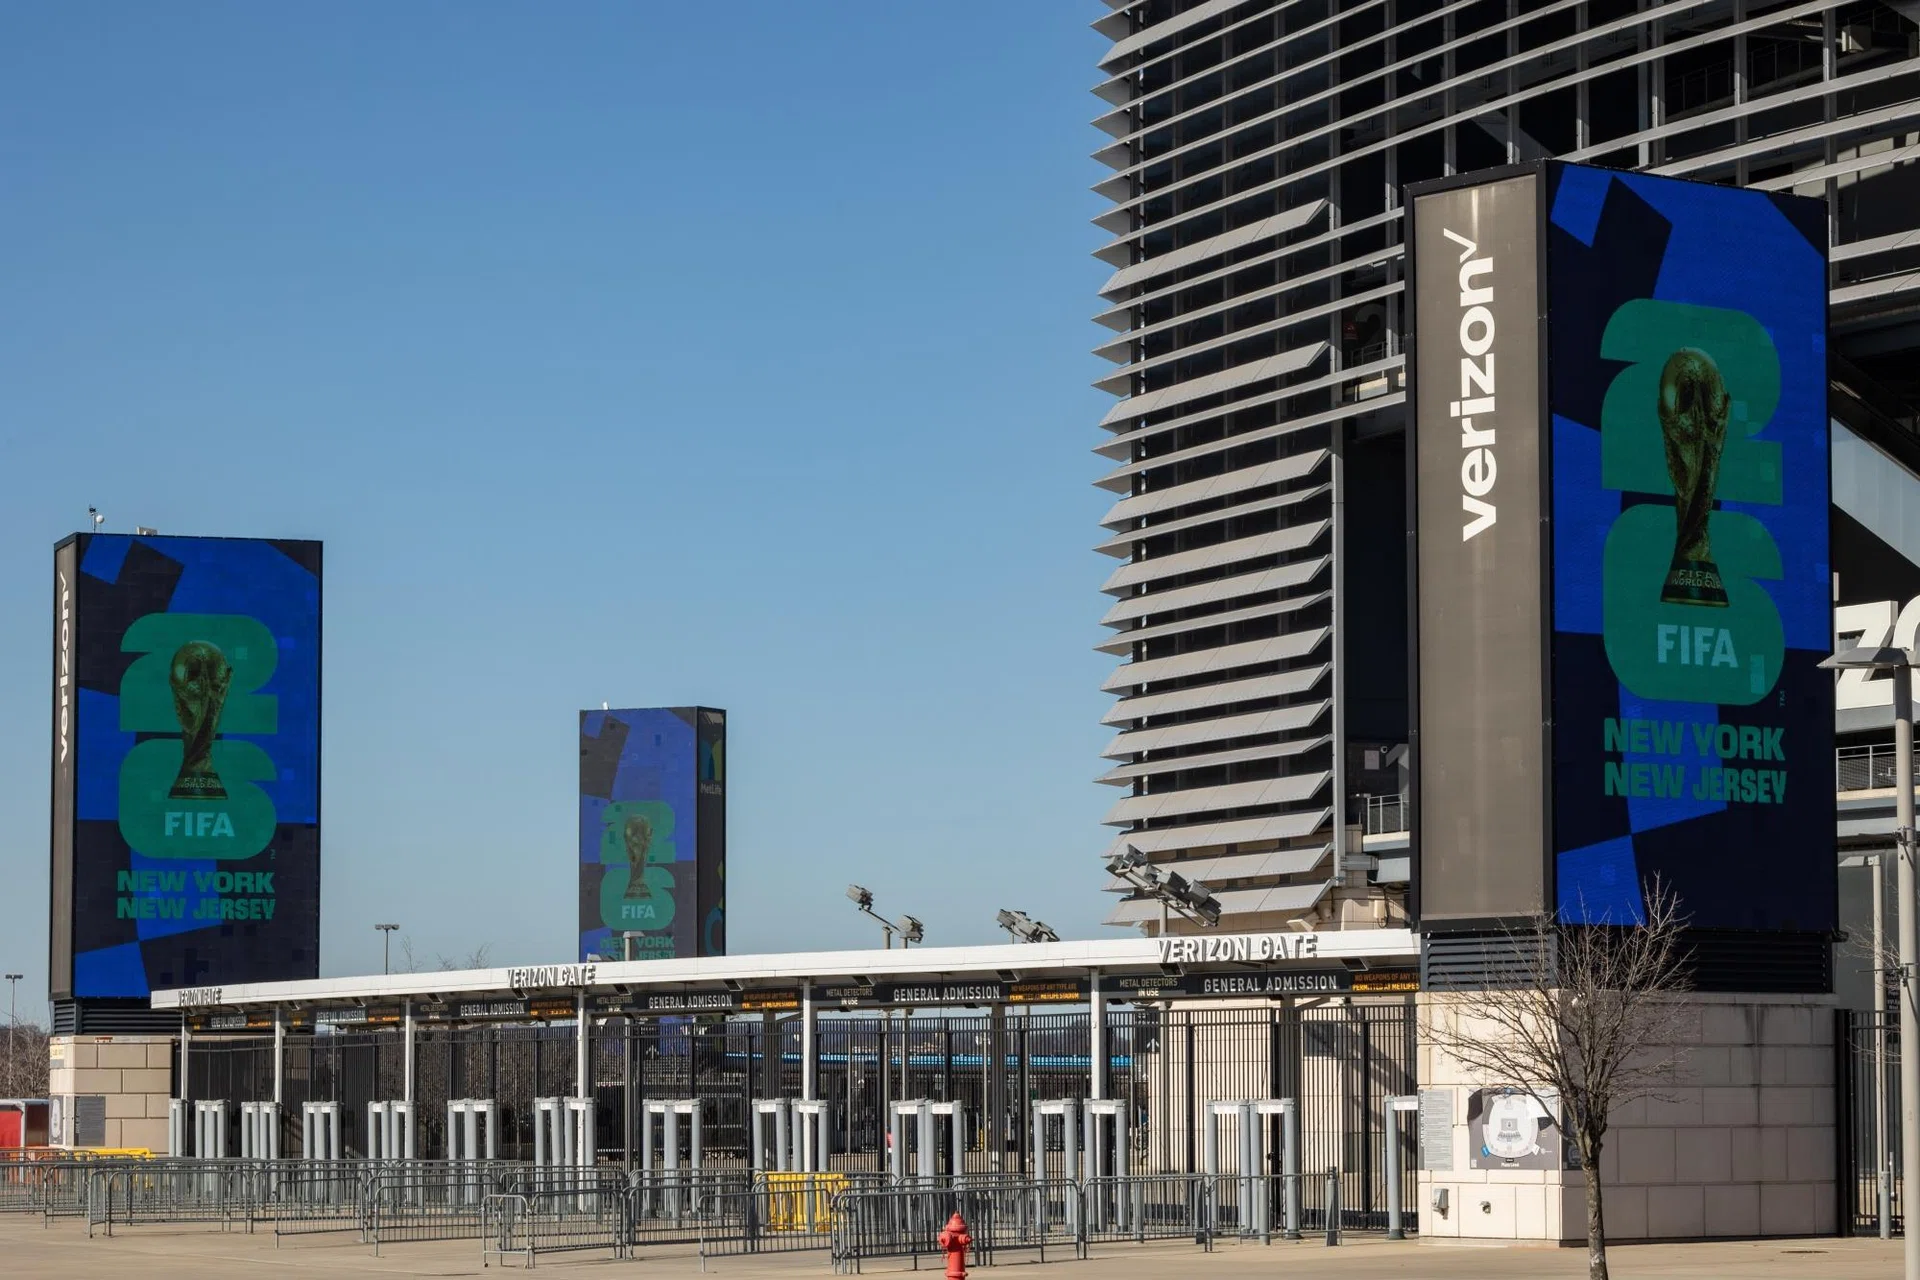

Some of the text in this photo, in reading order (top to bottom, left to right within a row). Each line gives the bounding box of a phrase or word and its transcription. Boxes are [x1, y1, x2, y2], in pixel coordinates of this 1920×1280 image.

[1450, 257, 1497, 542] verizon
[1657, 623, 1739, 668] FIFA
[59, 590, 69, 763] verizon
[1603, 717, 1786, 761] NEW YORK
[1604, 761, 1788, 804] NEW JERSEY
[165, 811, 235, 837] FIFA
[117, 870, 275, 893] NEW YORK
[116, 897, 277, 920] NEW JERSEY
[621, 904, 656, 919] FIFA
[636, 936, 674, 948] YORK
[1157, 933, 1318, 963] VERIZON GATE
[508, 964, 596, 988] VERIZON GATE
[1120, 977, 1178, 988] METAL DETECTORS
[1204, 975, 1337, 993] GENERAL ADMISSION
[178, 988, 202, 1006] VERIZON
[648, 997, 685, 1009] GENERAL
[687, 995, 733, 1008] ADMISSION
[826, 987, 873, 997] METAL DETECTORS
[893, 985, 1000, 1002] GENERAL ADMISSION
[1138, 987, 1159, 997] IN USE
[460, 1005, 488, 1017] GENERAL
[489, 1003, 525, 1016] ADMISSION
